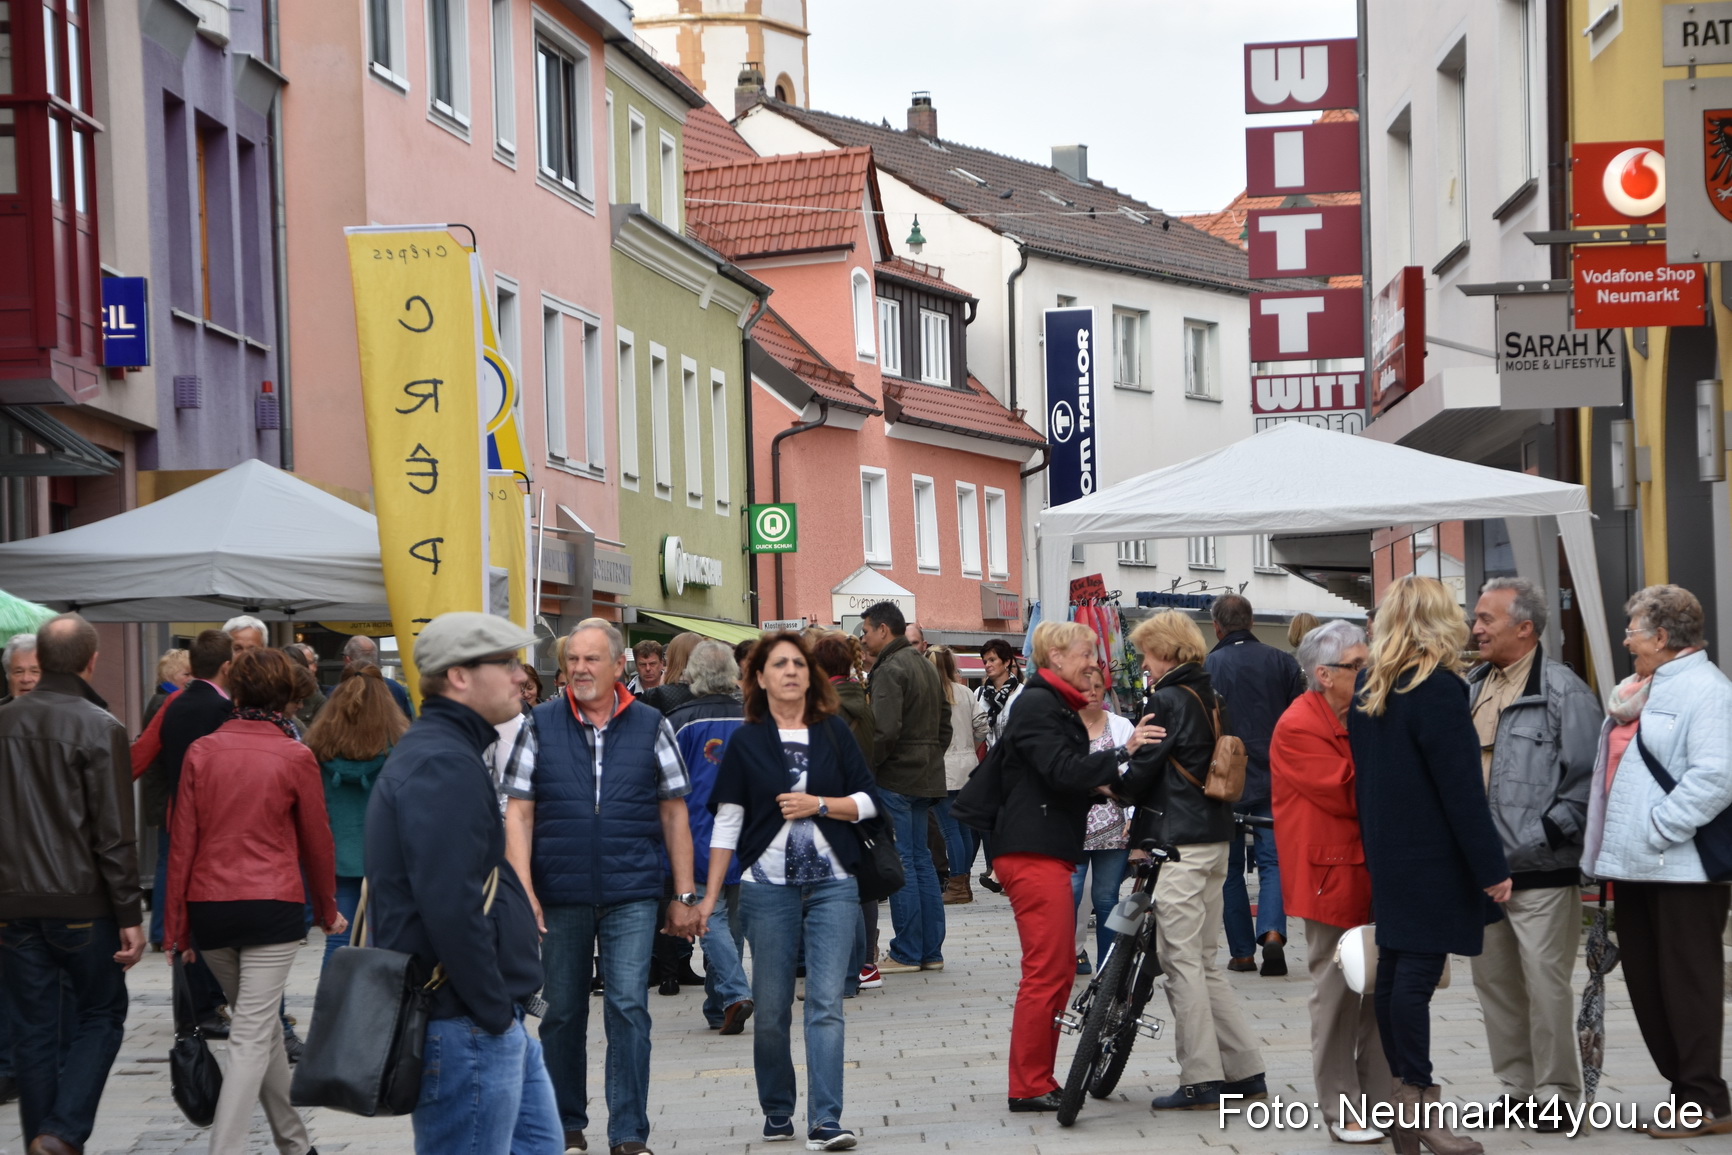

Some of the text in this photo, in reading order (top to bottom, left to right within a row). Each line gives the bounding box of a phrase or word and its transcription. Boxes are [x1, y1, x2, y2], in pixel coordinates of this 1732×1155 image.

[1251, 45, 1328, 353] WITT
[1582, 266, 1696, 284] Vodafone Shop
[1597, 287, 1680, 304] Neumarkt
[1505, 328, 1615, 359] SARAH K
[1505, 357, 1616, 371] MODE & LIFESTYLE
[1077, 328, 1091, 432] TAILOR
[1256, 374, 1360, 411] WITT
